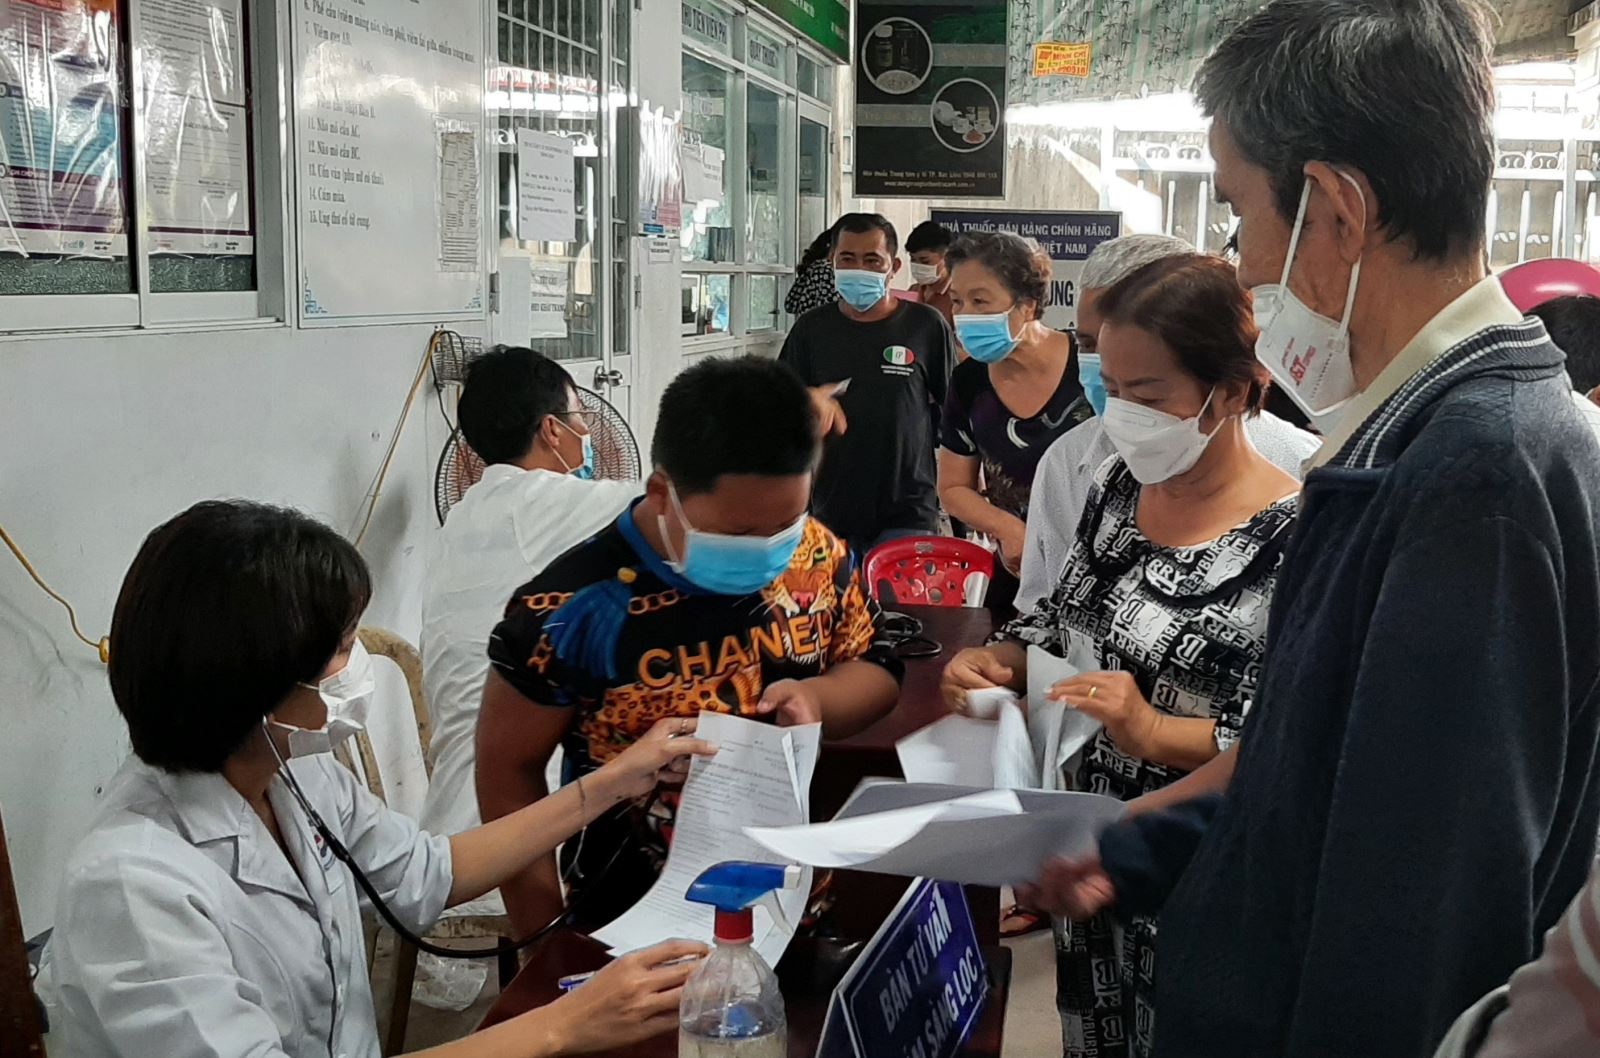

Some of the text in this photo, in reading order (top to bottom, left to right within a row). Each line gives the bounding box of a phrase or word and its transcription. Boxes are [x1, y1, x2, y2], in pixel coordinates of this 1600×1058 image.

[962, 219, 996, 233] THUỐC
[1021, 221, 1049, 235] HÀNG
[1050, 222, 1081, 236] CHÍNH
[1084, 222, 1111, 236] HÃNG
[1065, 243, 1088, 254] NAM
[637, 612, 834, 690] CHANEL
[879, 960, 913, 1034] BÀN
[953, 946, 979, 1007] LỌC
